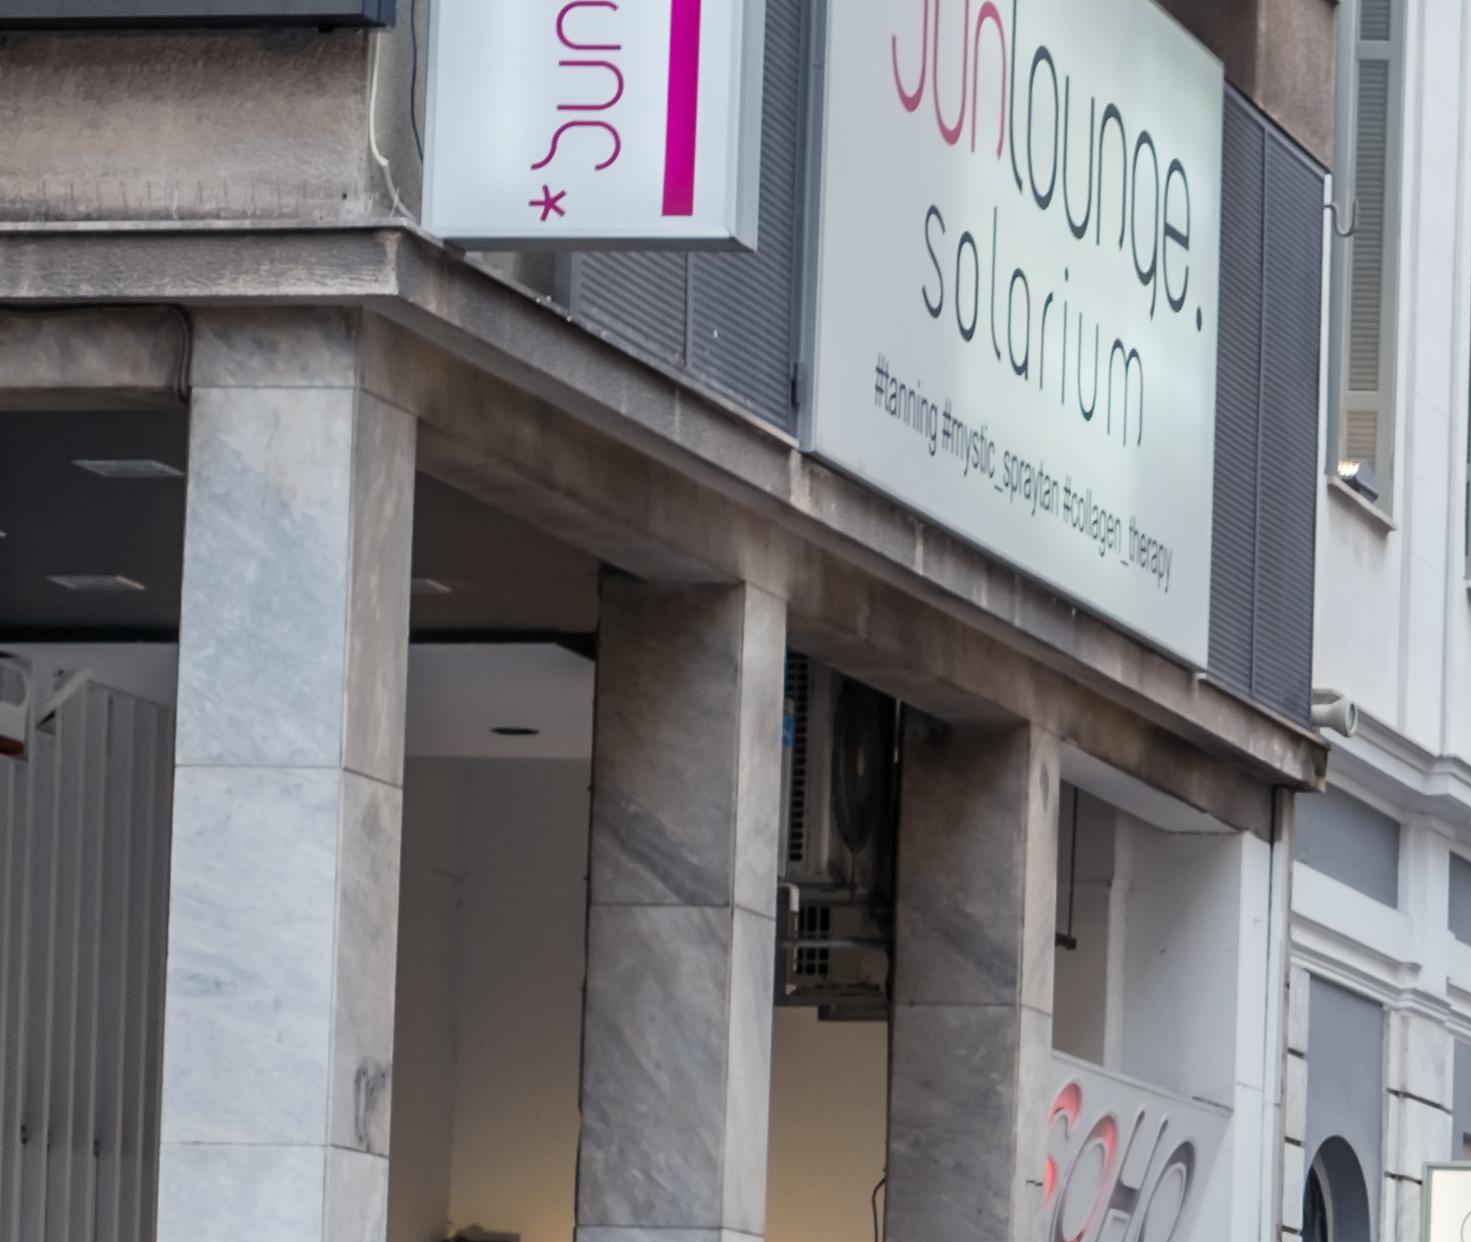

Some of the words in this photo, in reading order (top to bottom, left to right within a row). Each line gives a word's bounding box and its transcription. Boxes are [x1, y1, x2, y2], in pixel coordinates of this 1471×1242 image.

[921, 204, 1144, 447] solarium
[872, 354, 940, 456] #tanning
[941, 399, 1061, 519] #mystic_spraytan
